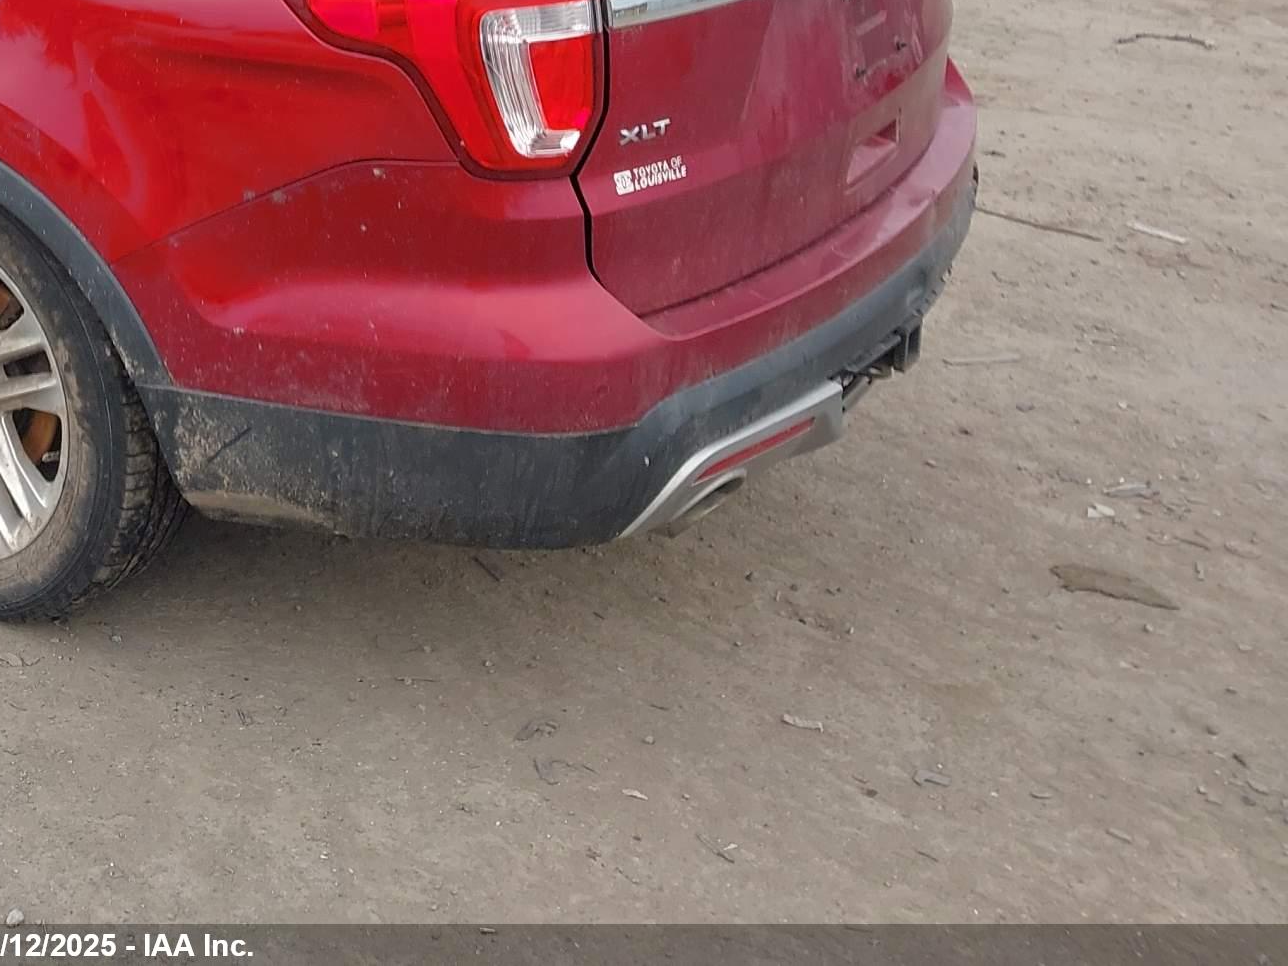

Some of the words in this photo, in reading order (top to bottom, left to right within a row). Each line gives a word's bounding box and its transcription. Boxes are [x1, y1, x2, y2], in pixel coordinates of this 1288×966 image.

[619, 118, 671, 146] XLT
[633, 159, 670, 179] TOYOTA
[670, 155, 683, 168] OF
[634, 164, 687, 191] LOUISVILLE
